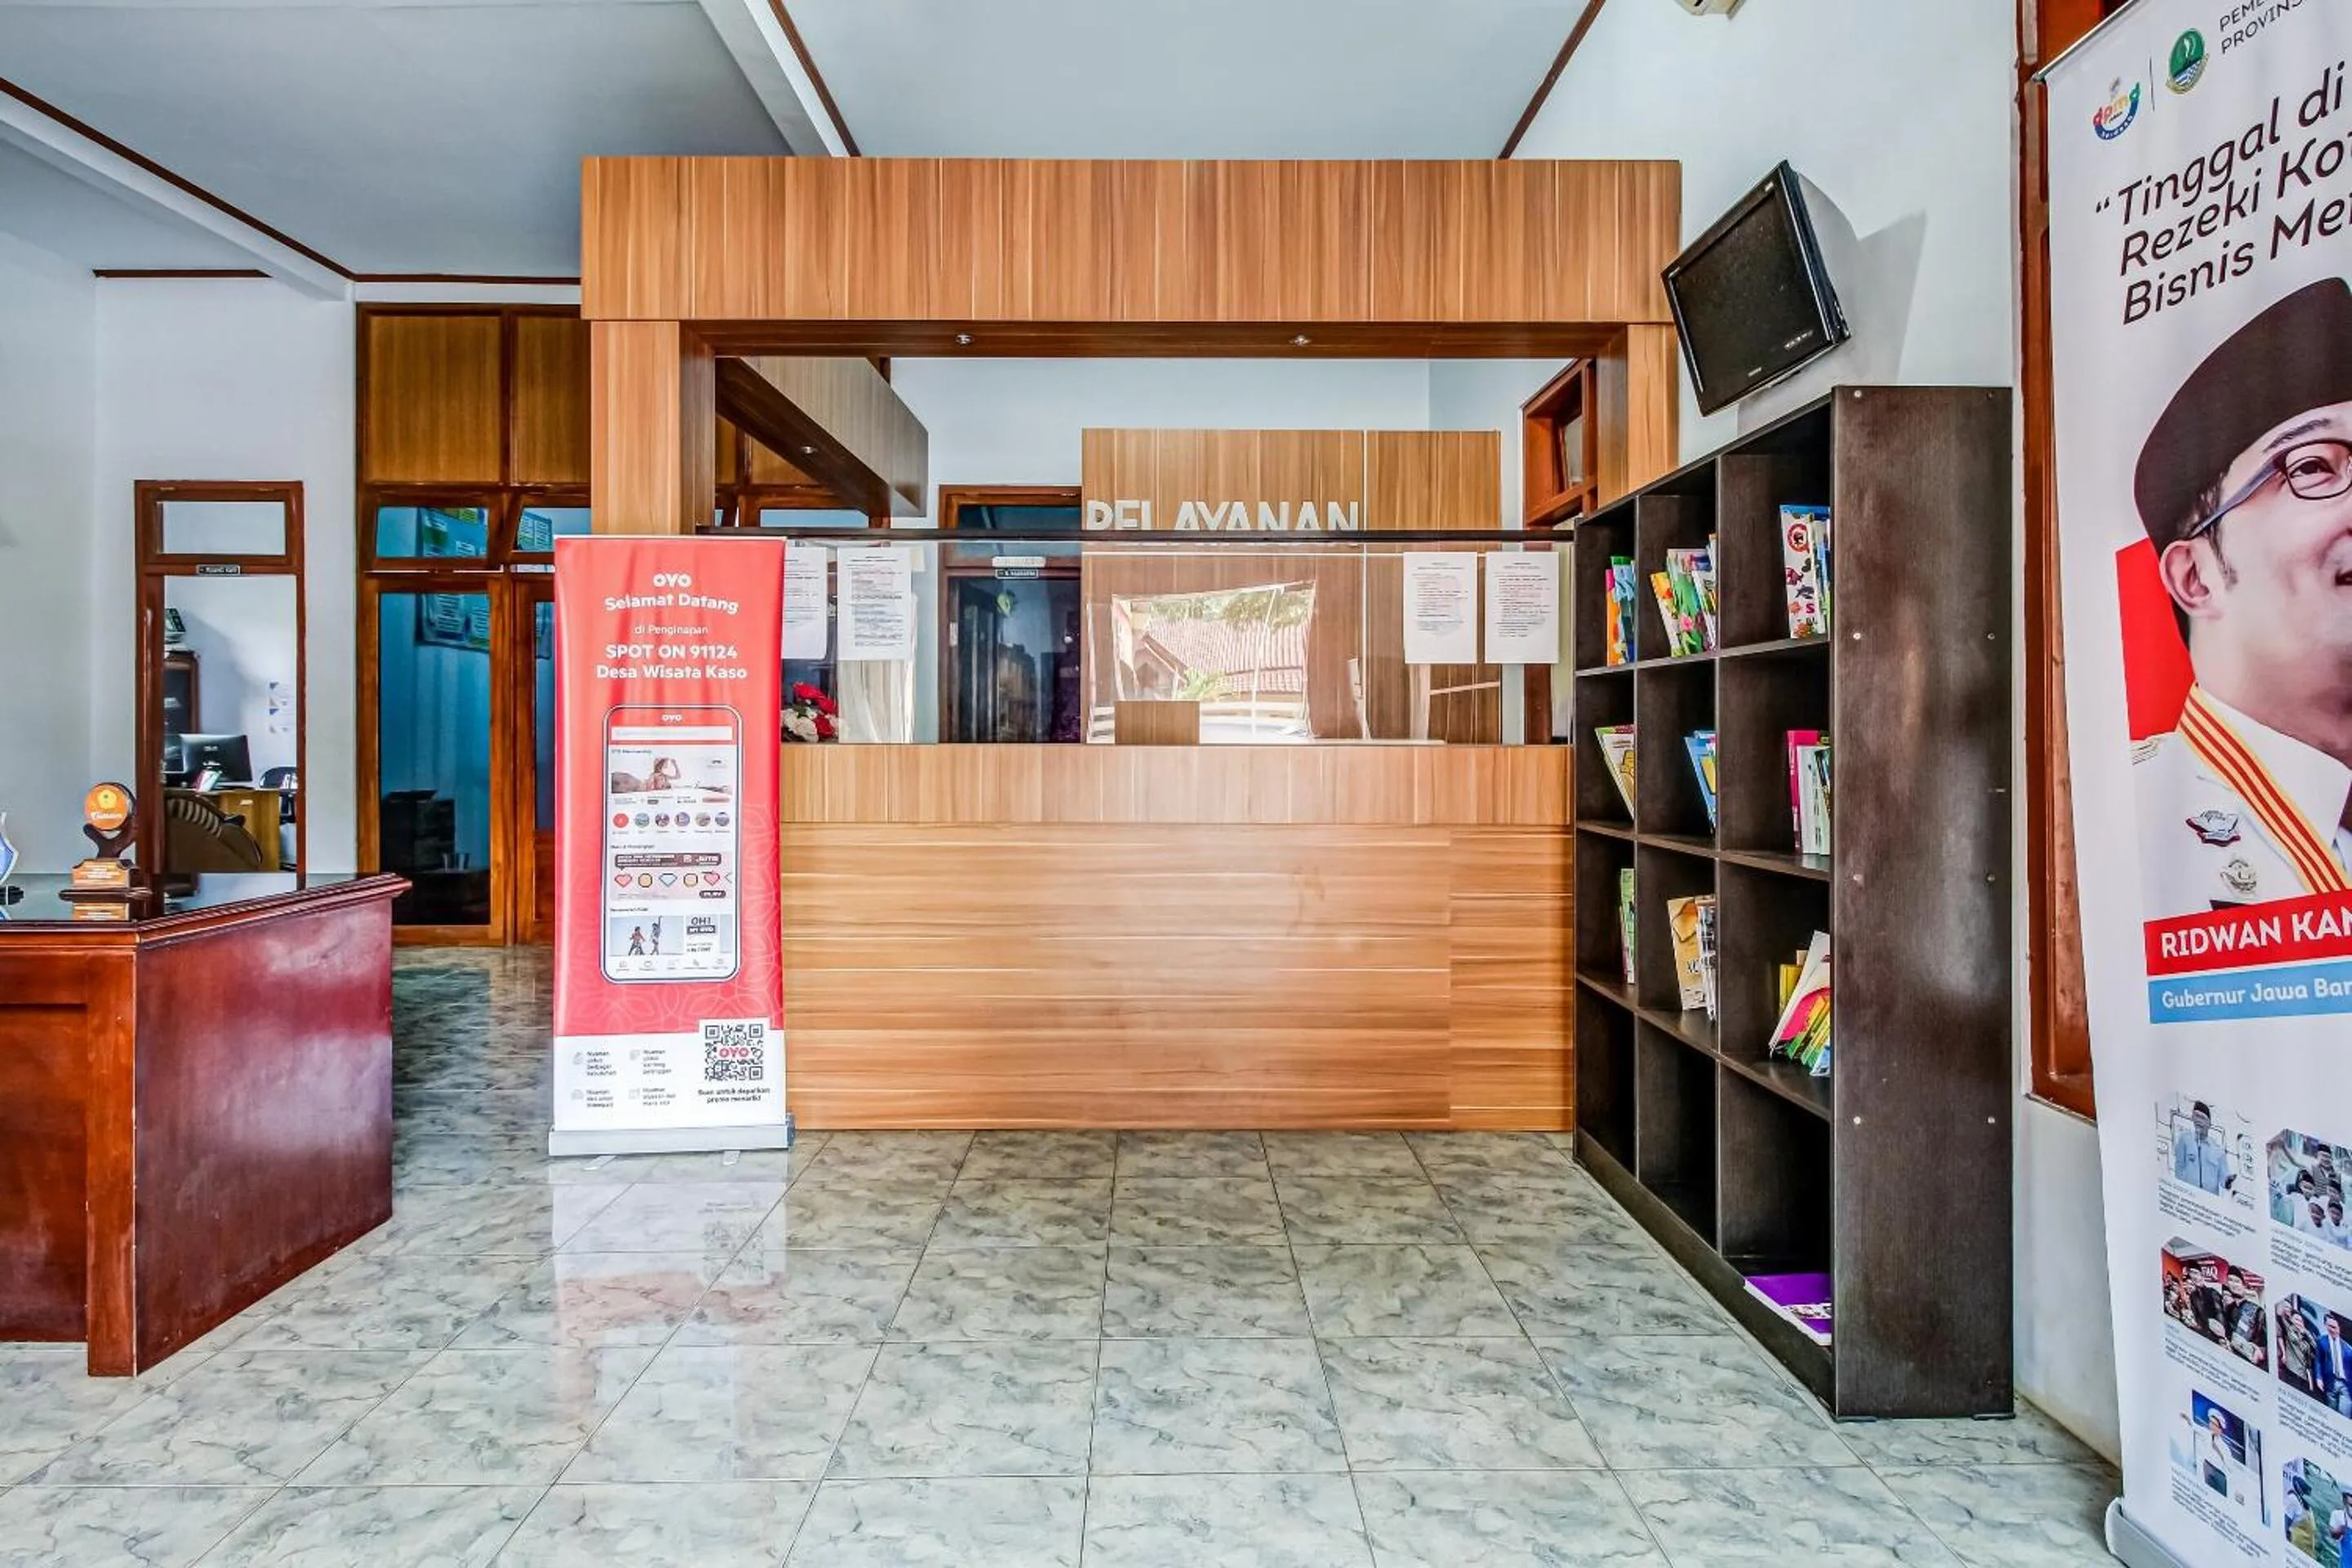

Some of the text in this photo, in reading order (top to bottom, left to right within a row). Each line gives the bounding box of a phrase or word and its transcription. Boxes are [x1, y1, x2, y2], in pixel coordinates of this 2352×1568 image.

[2296, 60, 2345, 128] di
[2120, 130, 2352, 277] Rezeki Ko
[2123, 191, 2352, 326] Bisnis Me
[653, 572, 693, 588] OYO
[604, 593, 739, 614] Selamat Datang
[635, 625, 709, 637] di Penginapan
[605, 644, 738, 660] SPOT ON 91124
[596, 665, 748, 679] Desa Wisata Kaso
[2160, 915, 2283, 959] RIDWAN
[2161, 988, 2246, 1009] Gubernur
[2250, 982, 2309, 1003] Jawa
[719, 1047, 751, 1059] OYO
